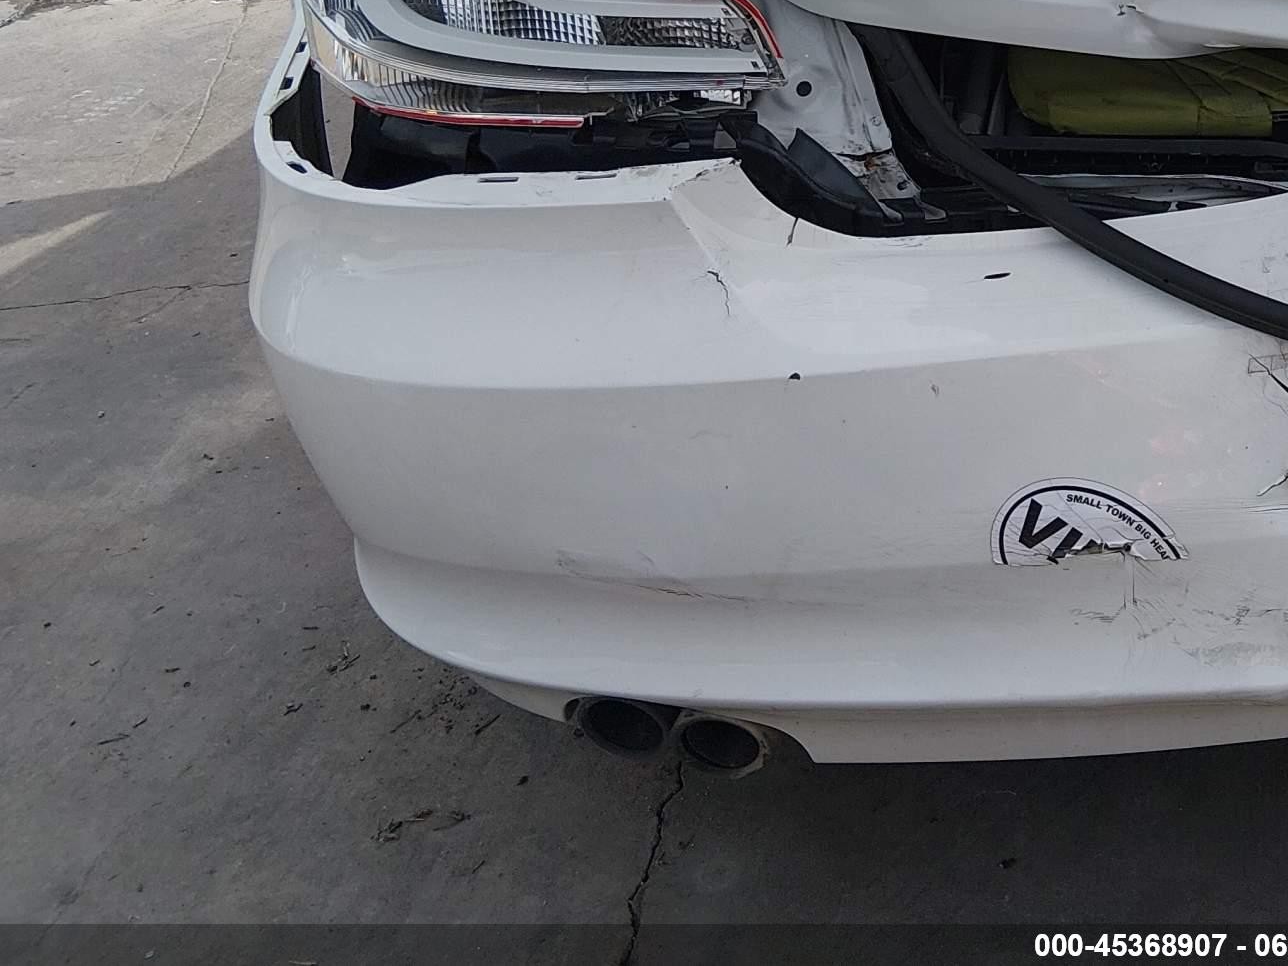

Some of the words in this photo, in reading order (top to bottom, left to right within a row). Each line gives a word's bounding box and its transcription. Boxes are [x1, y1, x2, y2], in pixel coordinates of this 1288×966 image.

[1065, 493, 1102, 510] SMALL
[1106, 503, 1135, 526] TOWN
[1134, 523, 1152, 540] BIG
